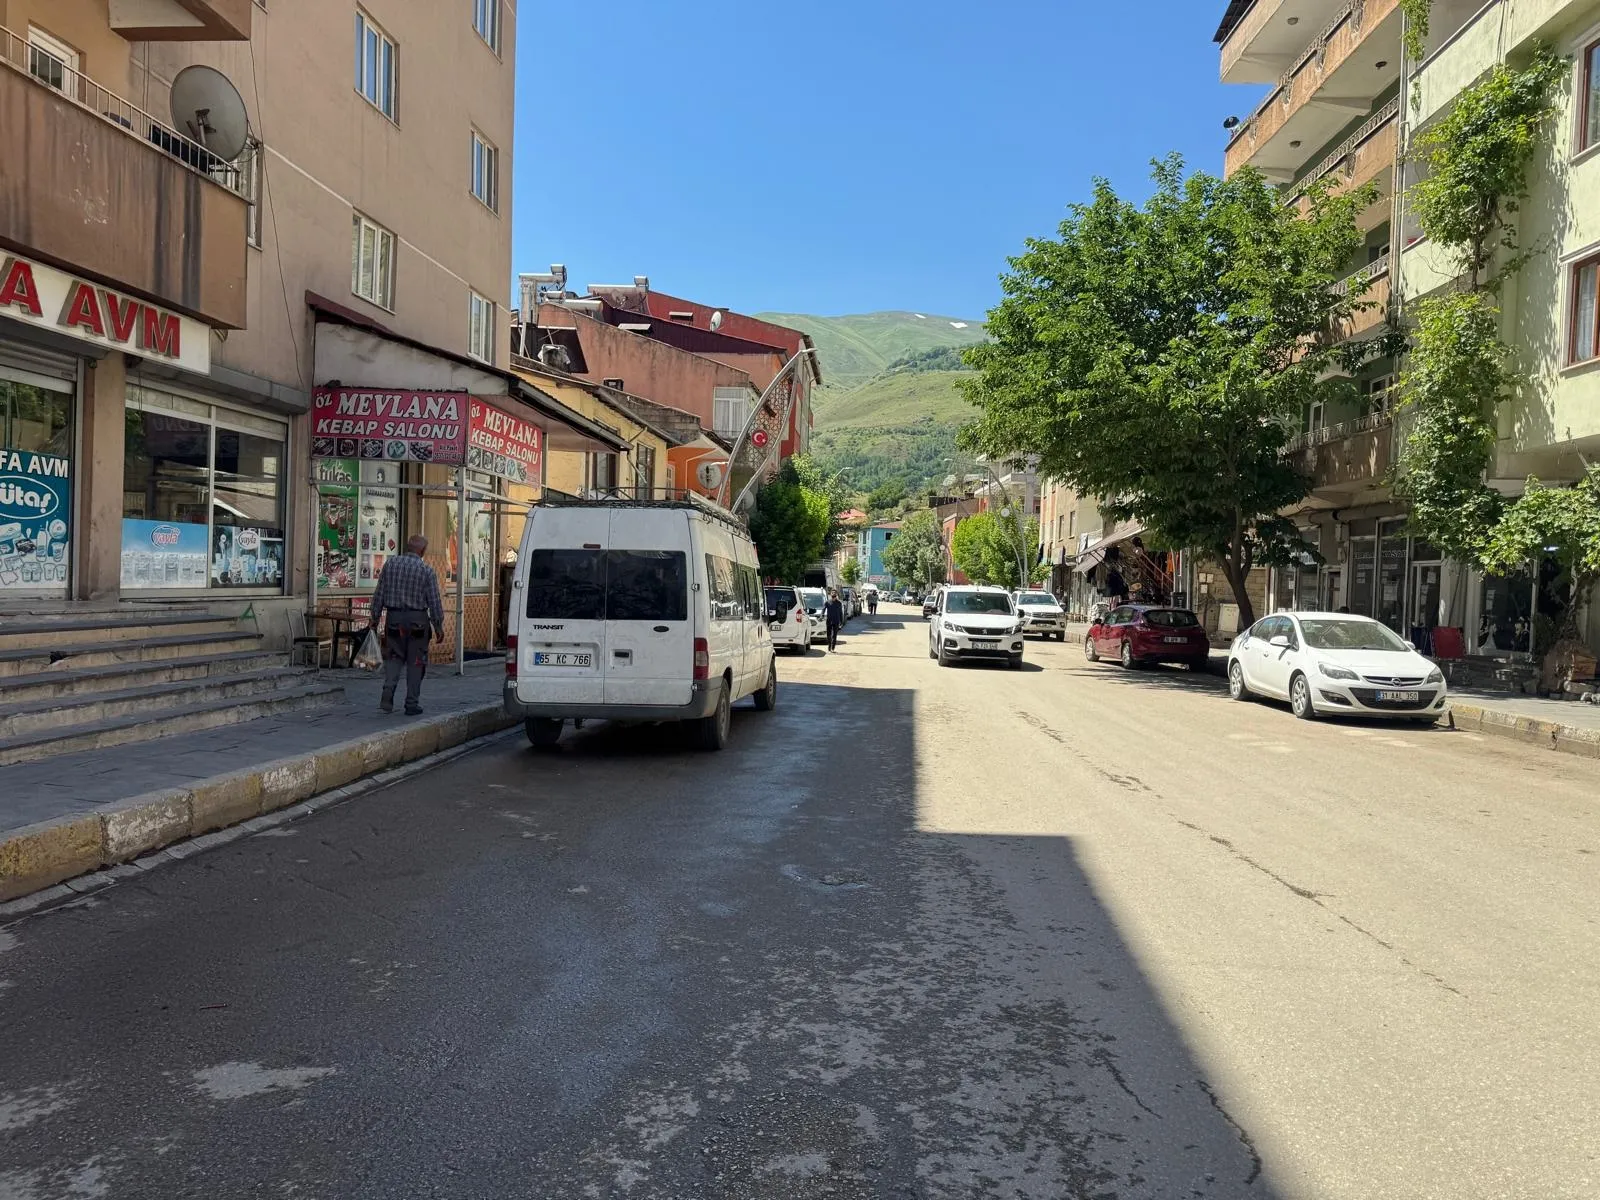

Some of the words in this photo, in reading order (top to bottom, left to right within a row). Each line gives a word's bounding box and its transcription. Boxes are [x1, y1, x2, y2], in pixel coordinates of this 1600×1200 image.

[0, 260, 42, 317] A
[65, 283, 181, 359] AVM
[336, 392, 459, 421] MEVLANA
[316, 418, 378, 435] KEBAP
[383, 423, 459, 440] SALONU
[483, 408, 538, 449] MEVLANA
[471, 428, 504, 450] KEBAP
[505, 442, 538, 465] SALONU
[27, 455, 69, 478] AVM
[539, 654, 550, 664] 65
[556, 654, 567, 664] KC
[573, 655, 590, 665] 766
